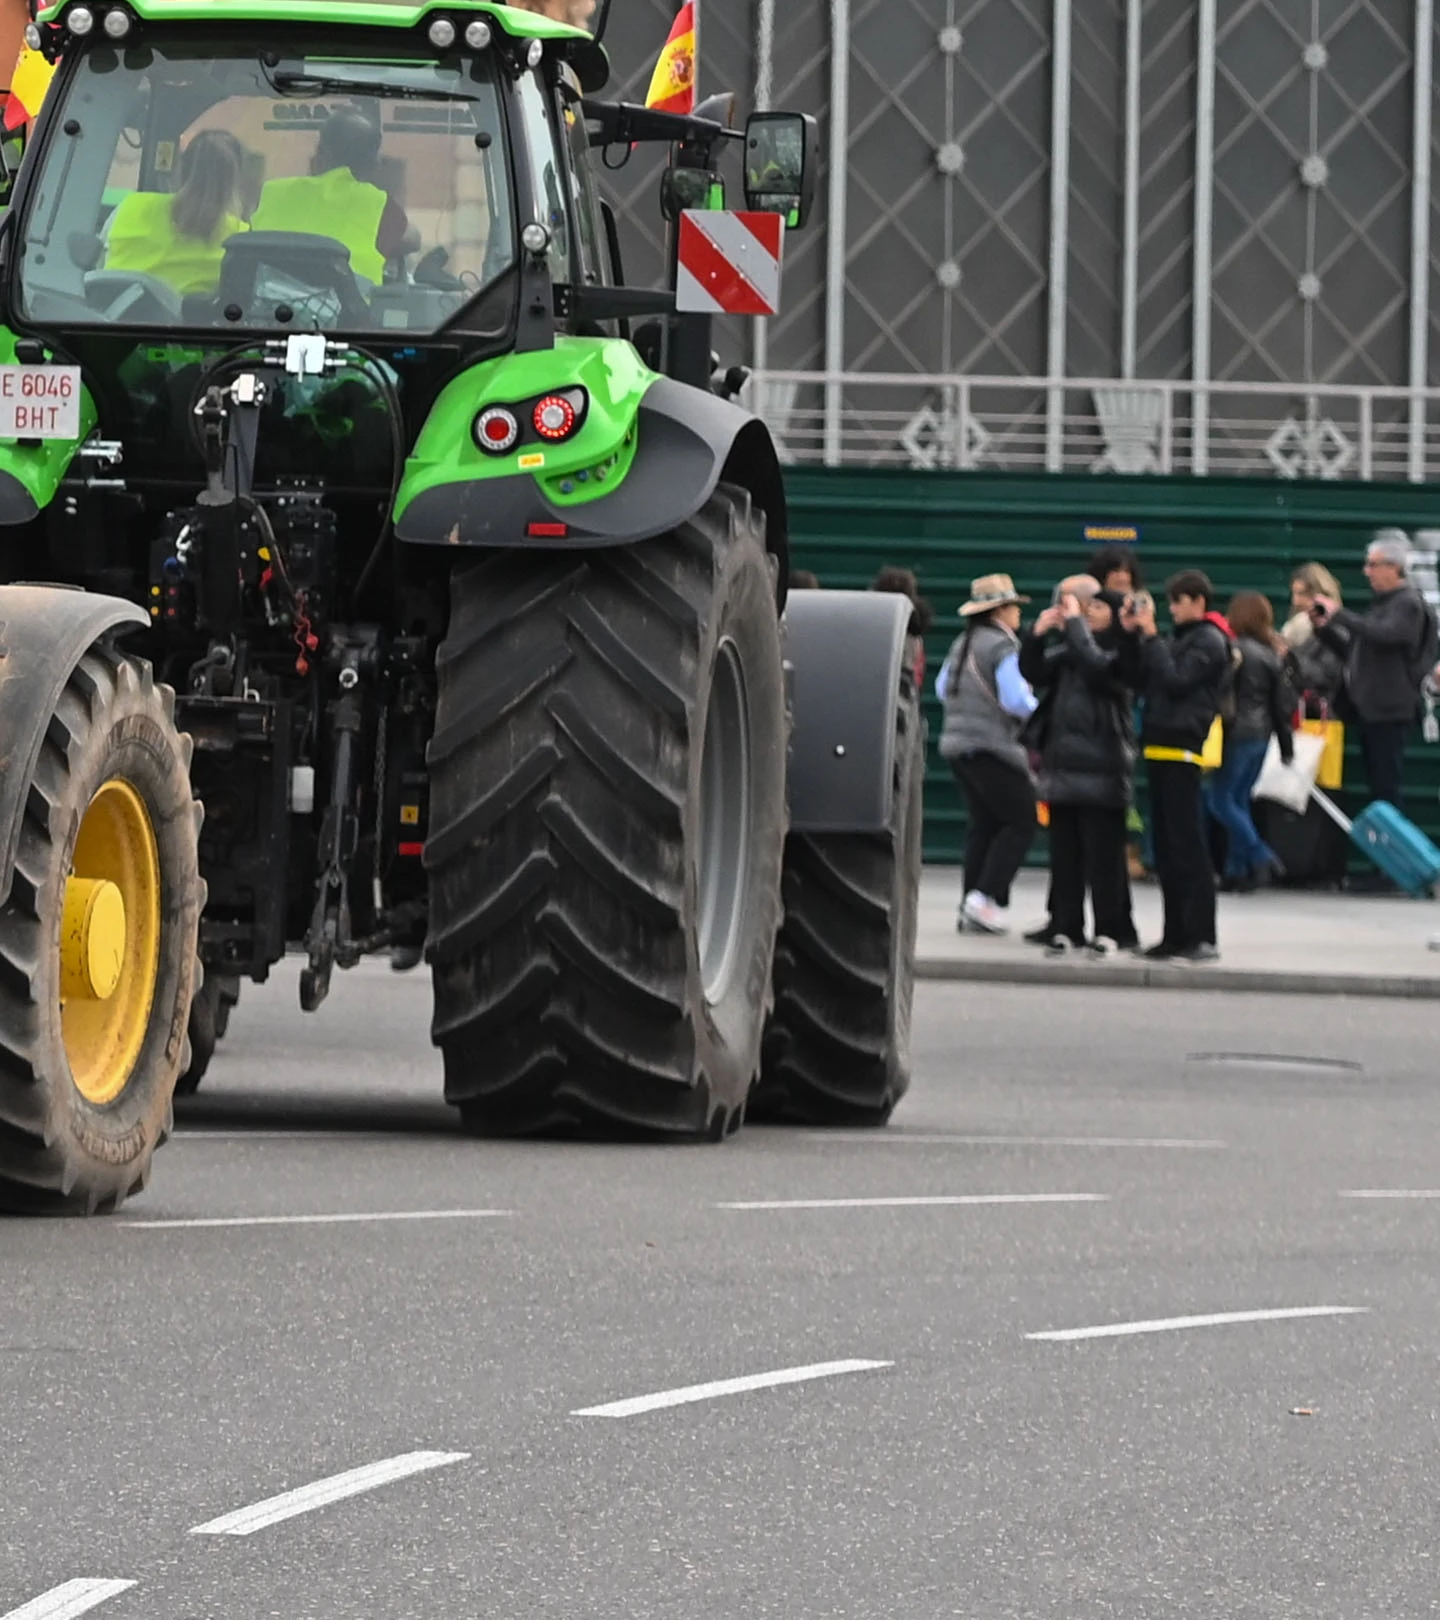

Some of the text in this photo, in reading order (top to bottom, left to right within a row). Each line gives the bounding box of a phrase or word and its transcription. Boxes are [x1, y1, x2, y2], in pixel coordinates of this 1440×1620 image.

[2, 373, 72, 398] E 6046
[15, 406, 59, 430] BHT
